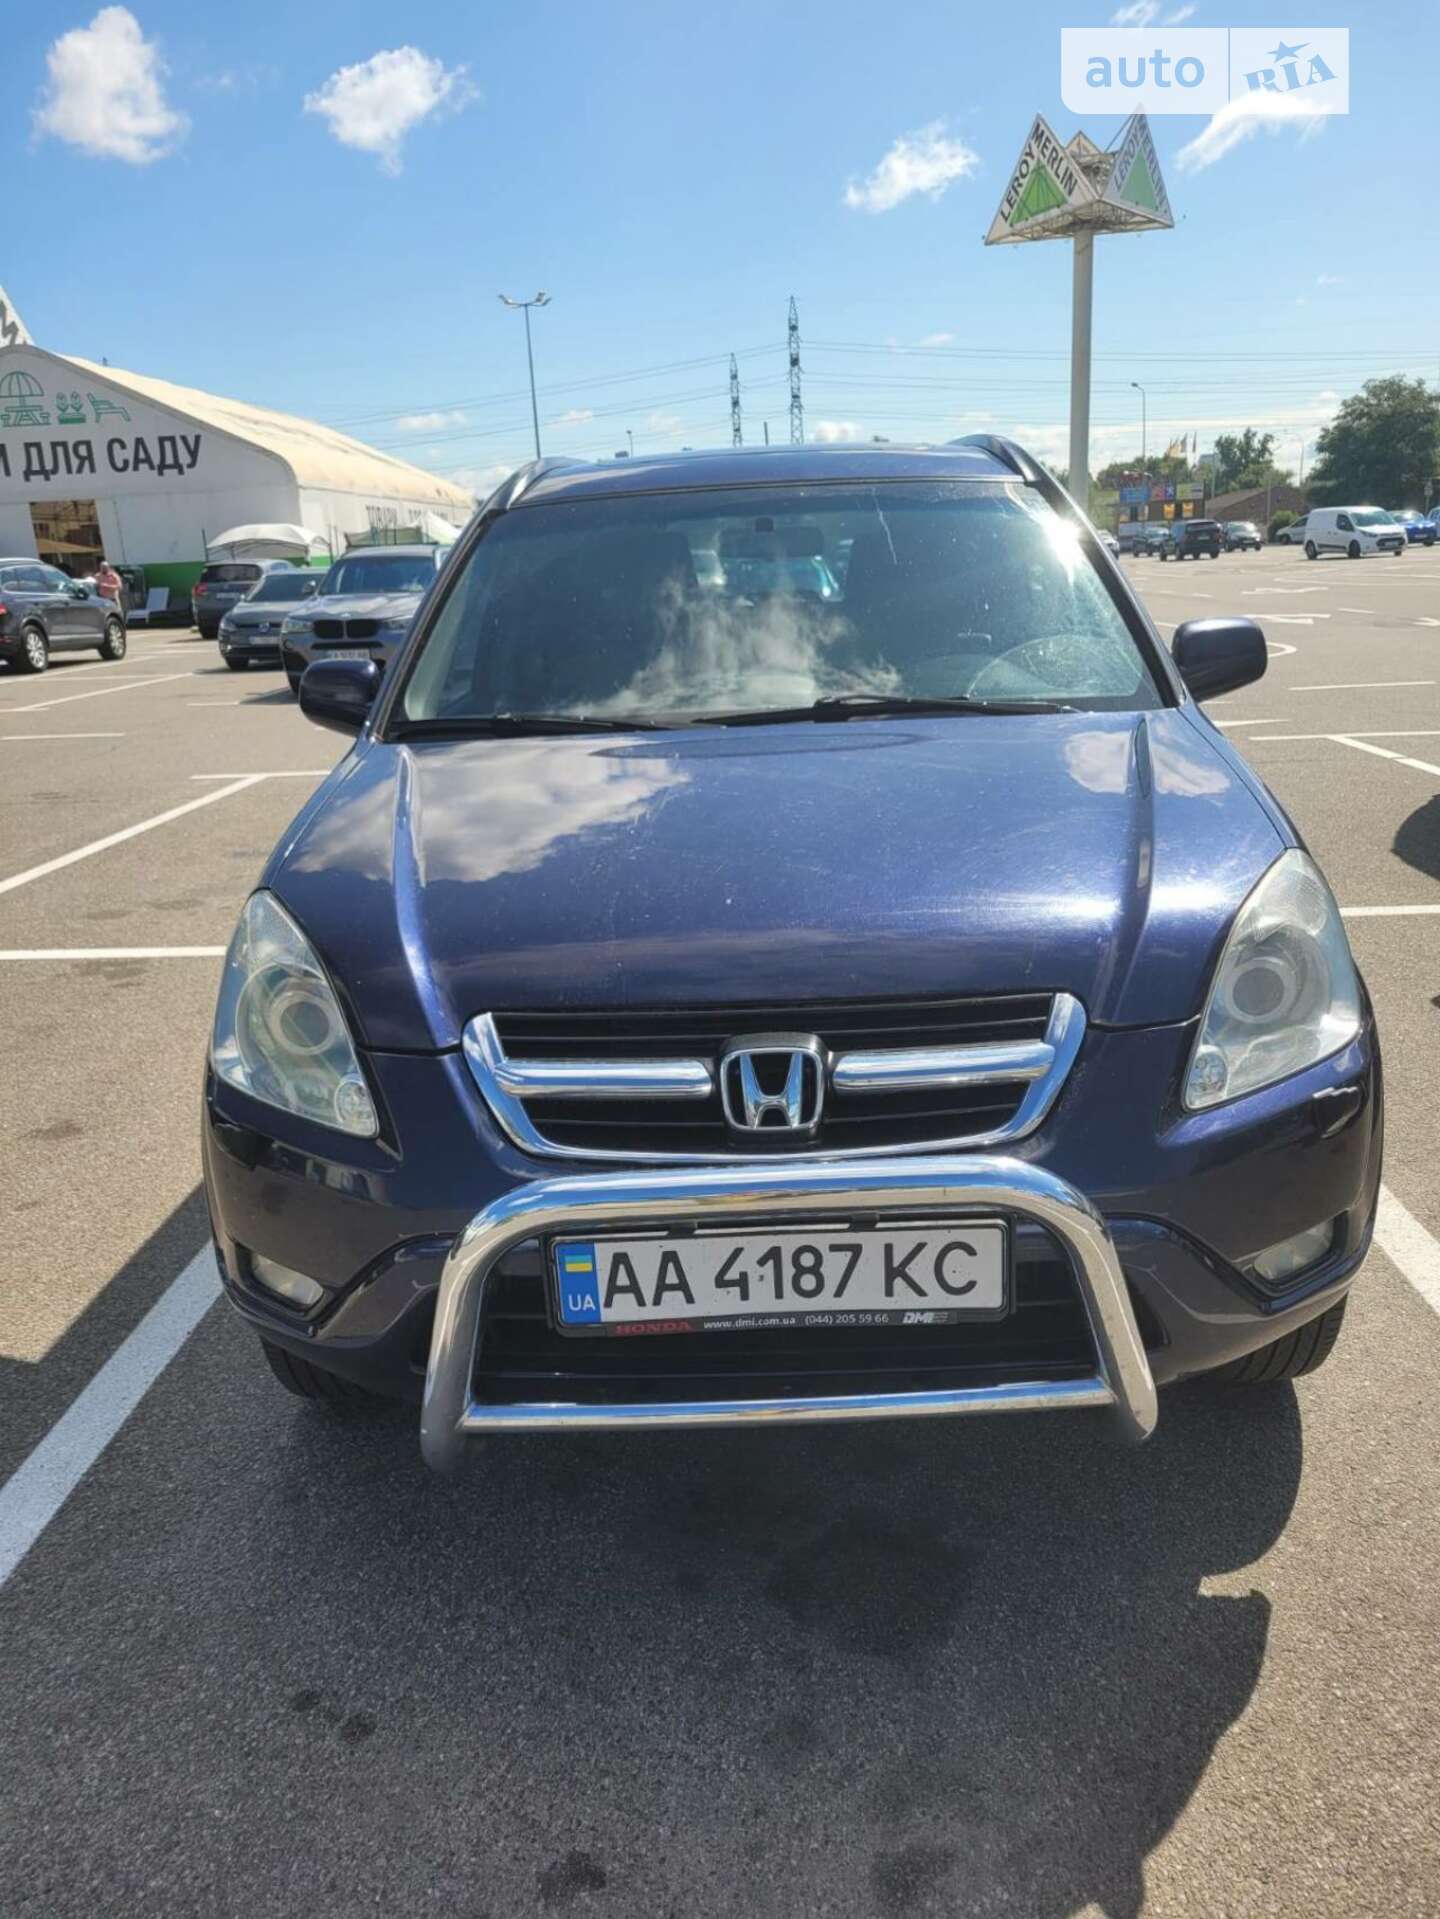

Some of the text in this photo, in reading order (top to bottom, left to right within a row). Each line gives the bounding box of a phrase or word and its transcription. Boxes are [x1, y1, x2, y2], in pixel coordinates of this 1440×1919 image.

[1000, 122, 1079, 222] LEROY MERLIN
[23, 440, 96, 482] ДЛЯ
[106, 434, 201, 477] САДУ
[603, 1240, 977, 1308] AA 4187 KC
[568, 1295, 596, 1311] UA
[616, 1321, 692, 1335] HONDA
[704, 1312, 889, 1329] www.dmi.com.ua (044) 205 59 66
